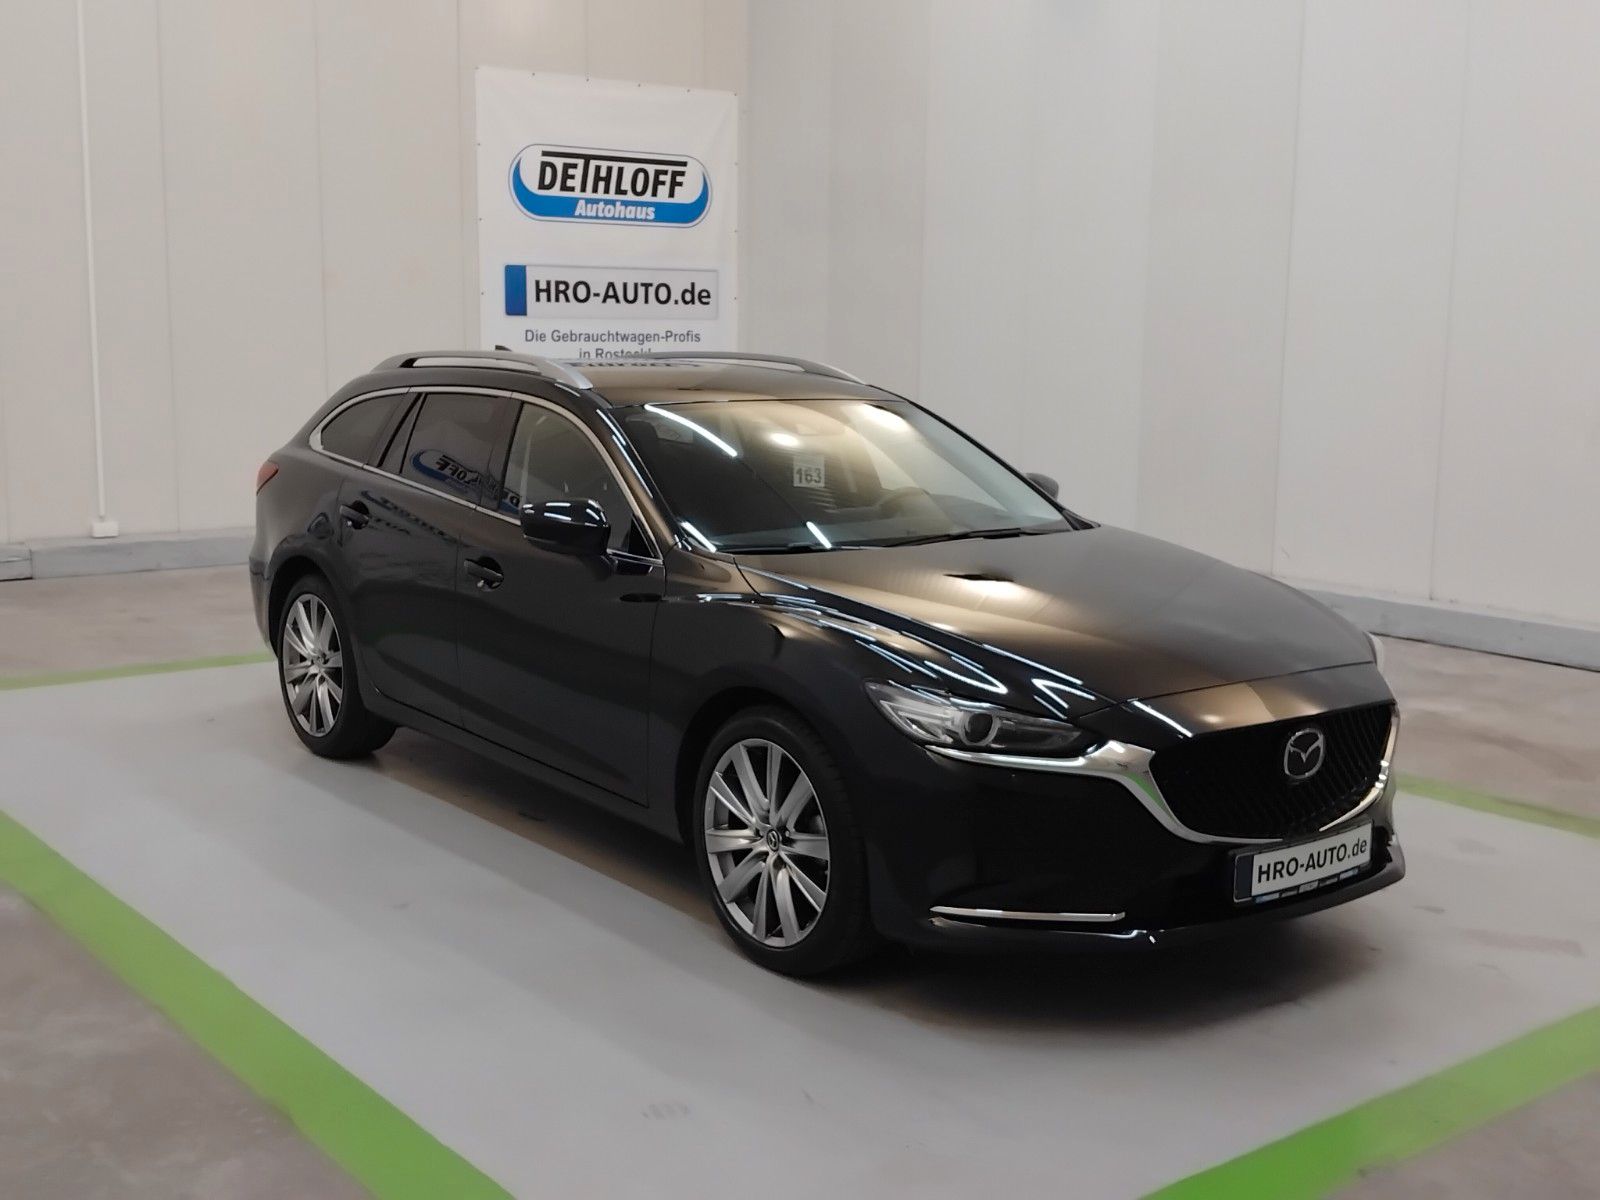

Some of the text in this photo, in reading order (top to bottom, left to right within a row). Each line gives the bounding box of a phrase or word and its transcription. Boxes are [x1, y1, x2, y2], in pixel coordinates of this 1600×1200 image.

[538, 150, 688, 198] DETHLOFF
[574, 200, 655, 220] Autohaus
[534, 280, 711, 305] HRO-AUTO.de
[524, 330, 701, 345] Die Gebrauchtwagen-Profis
[579, 348, 591, 358] in
[796, 467, 822, 484] 163
[1257, 838, 1367, 883] HRO-AUTO.de
